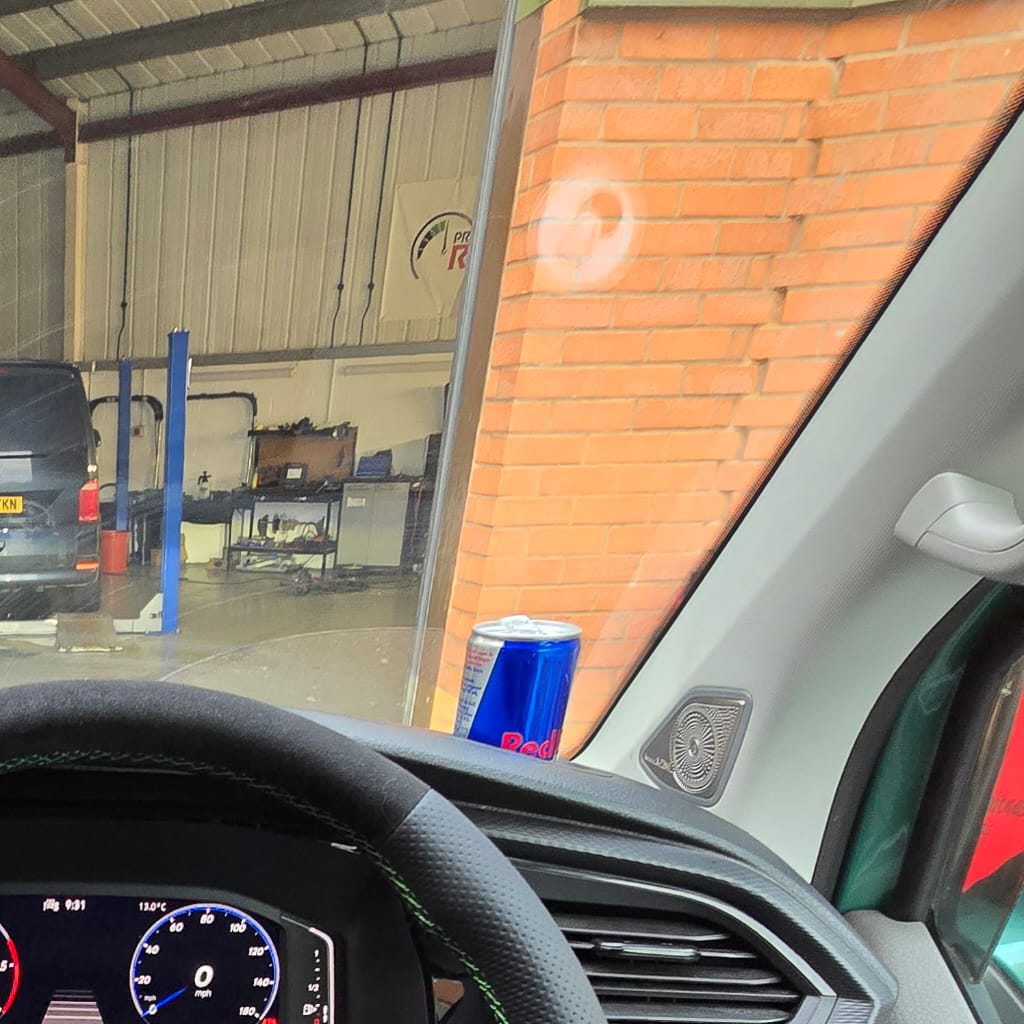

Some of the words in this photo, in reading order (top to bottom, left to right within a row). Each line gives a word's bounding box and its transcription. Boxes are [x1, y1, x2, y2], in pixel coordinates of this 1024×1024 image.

[169, 921, 185, 933] 60
[229, 922, 247, 934] 100
[136, 974, 152, 986] 20
[193, 964, 215, 989] 0
[194, 988, 213, 1000] mph
